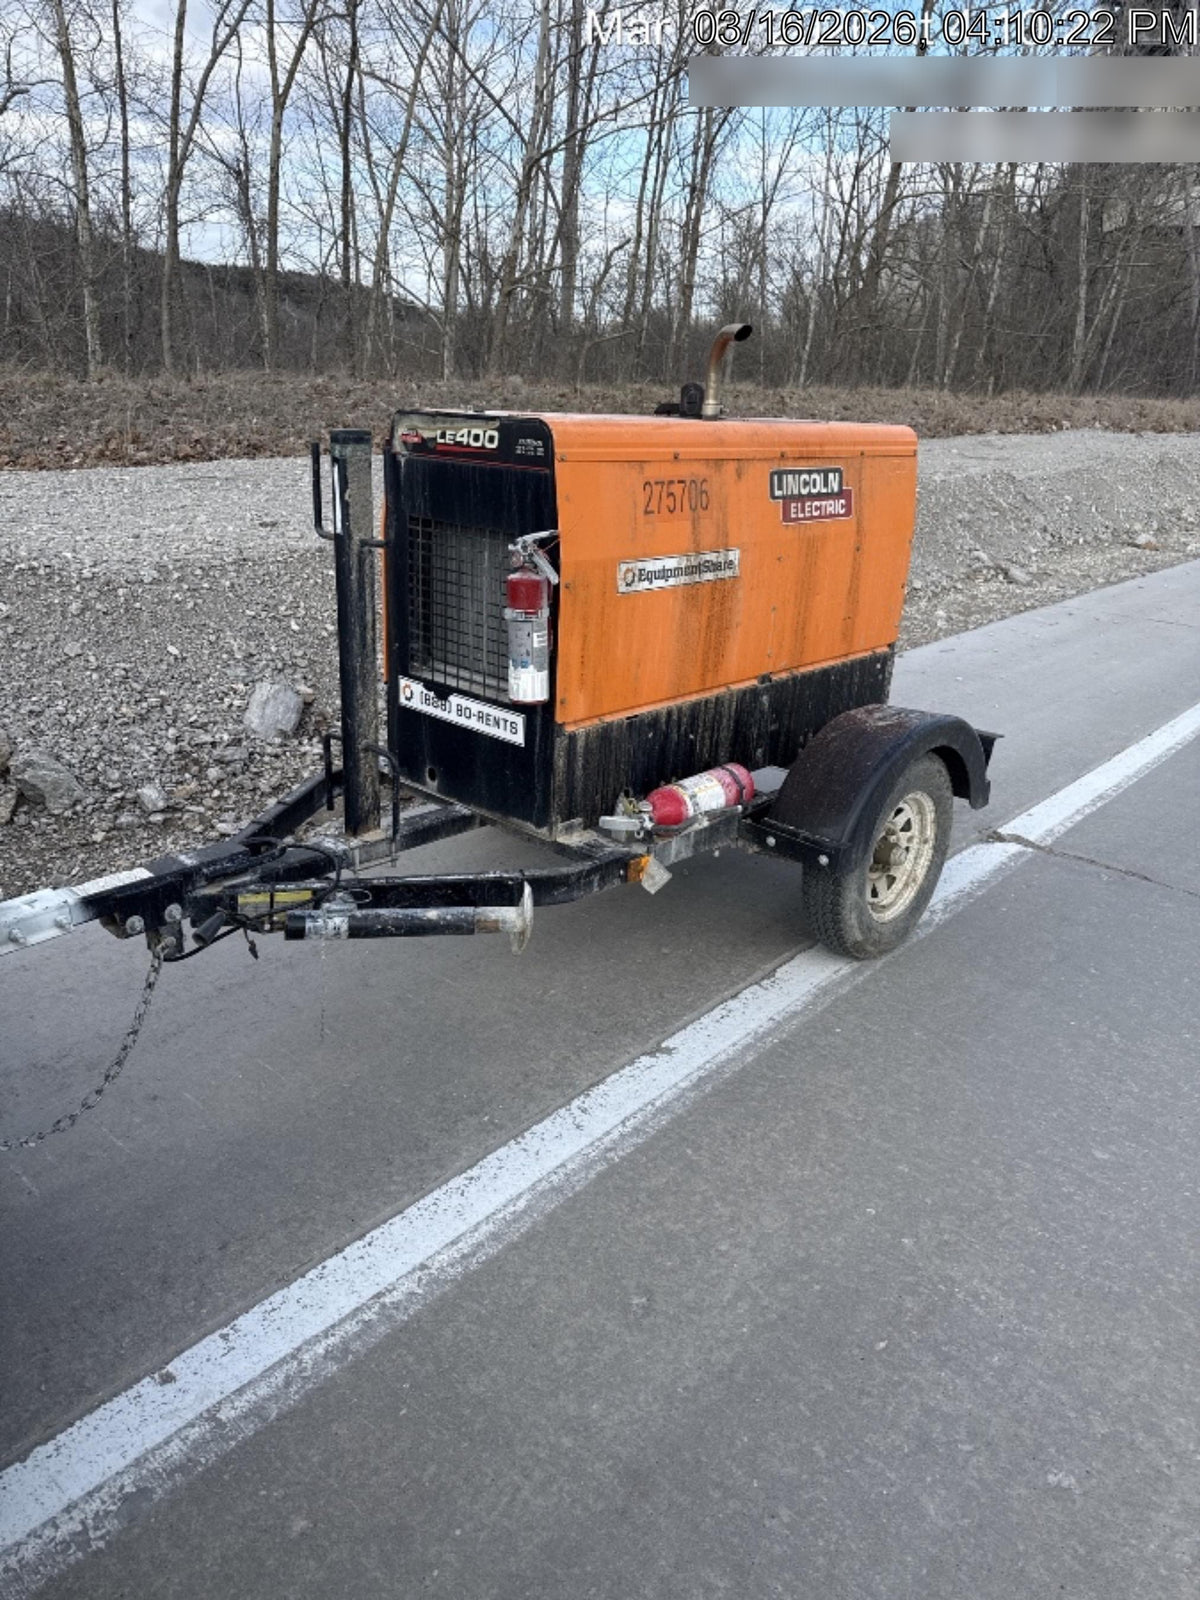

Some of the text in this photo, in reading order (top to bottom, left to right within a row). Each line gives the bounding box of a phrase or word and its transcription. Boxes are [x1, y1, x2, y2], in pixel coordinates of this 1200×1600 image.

[436, 428, 499, 449] LE400
[773, 472, 840, 496] LINCOLN
[643, 478, 710, 516] 275706
[790, 499, 846, 519] ELECTRIC
[638, 559, 735, 585] EquipmentShare
